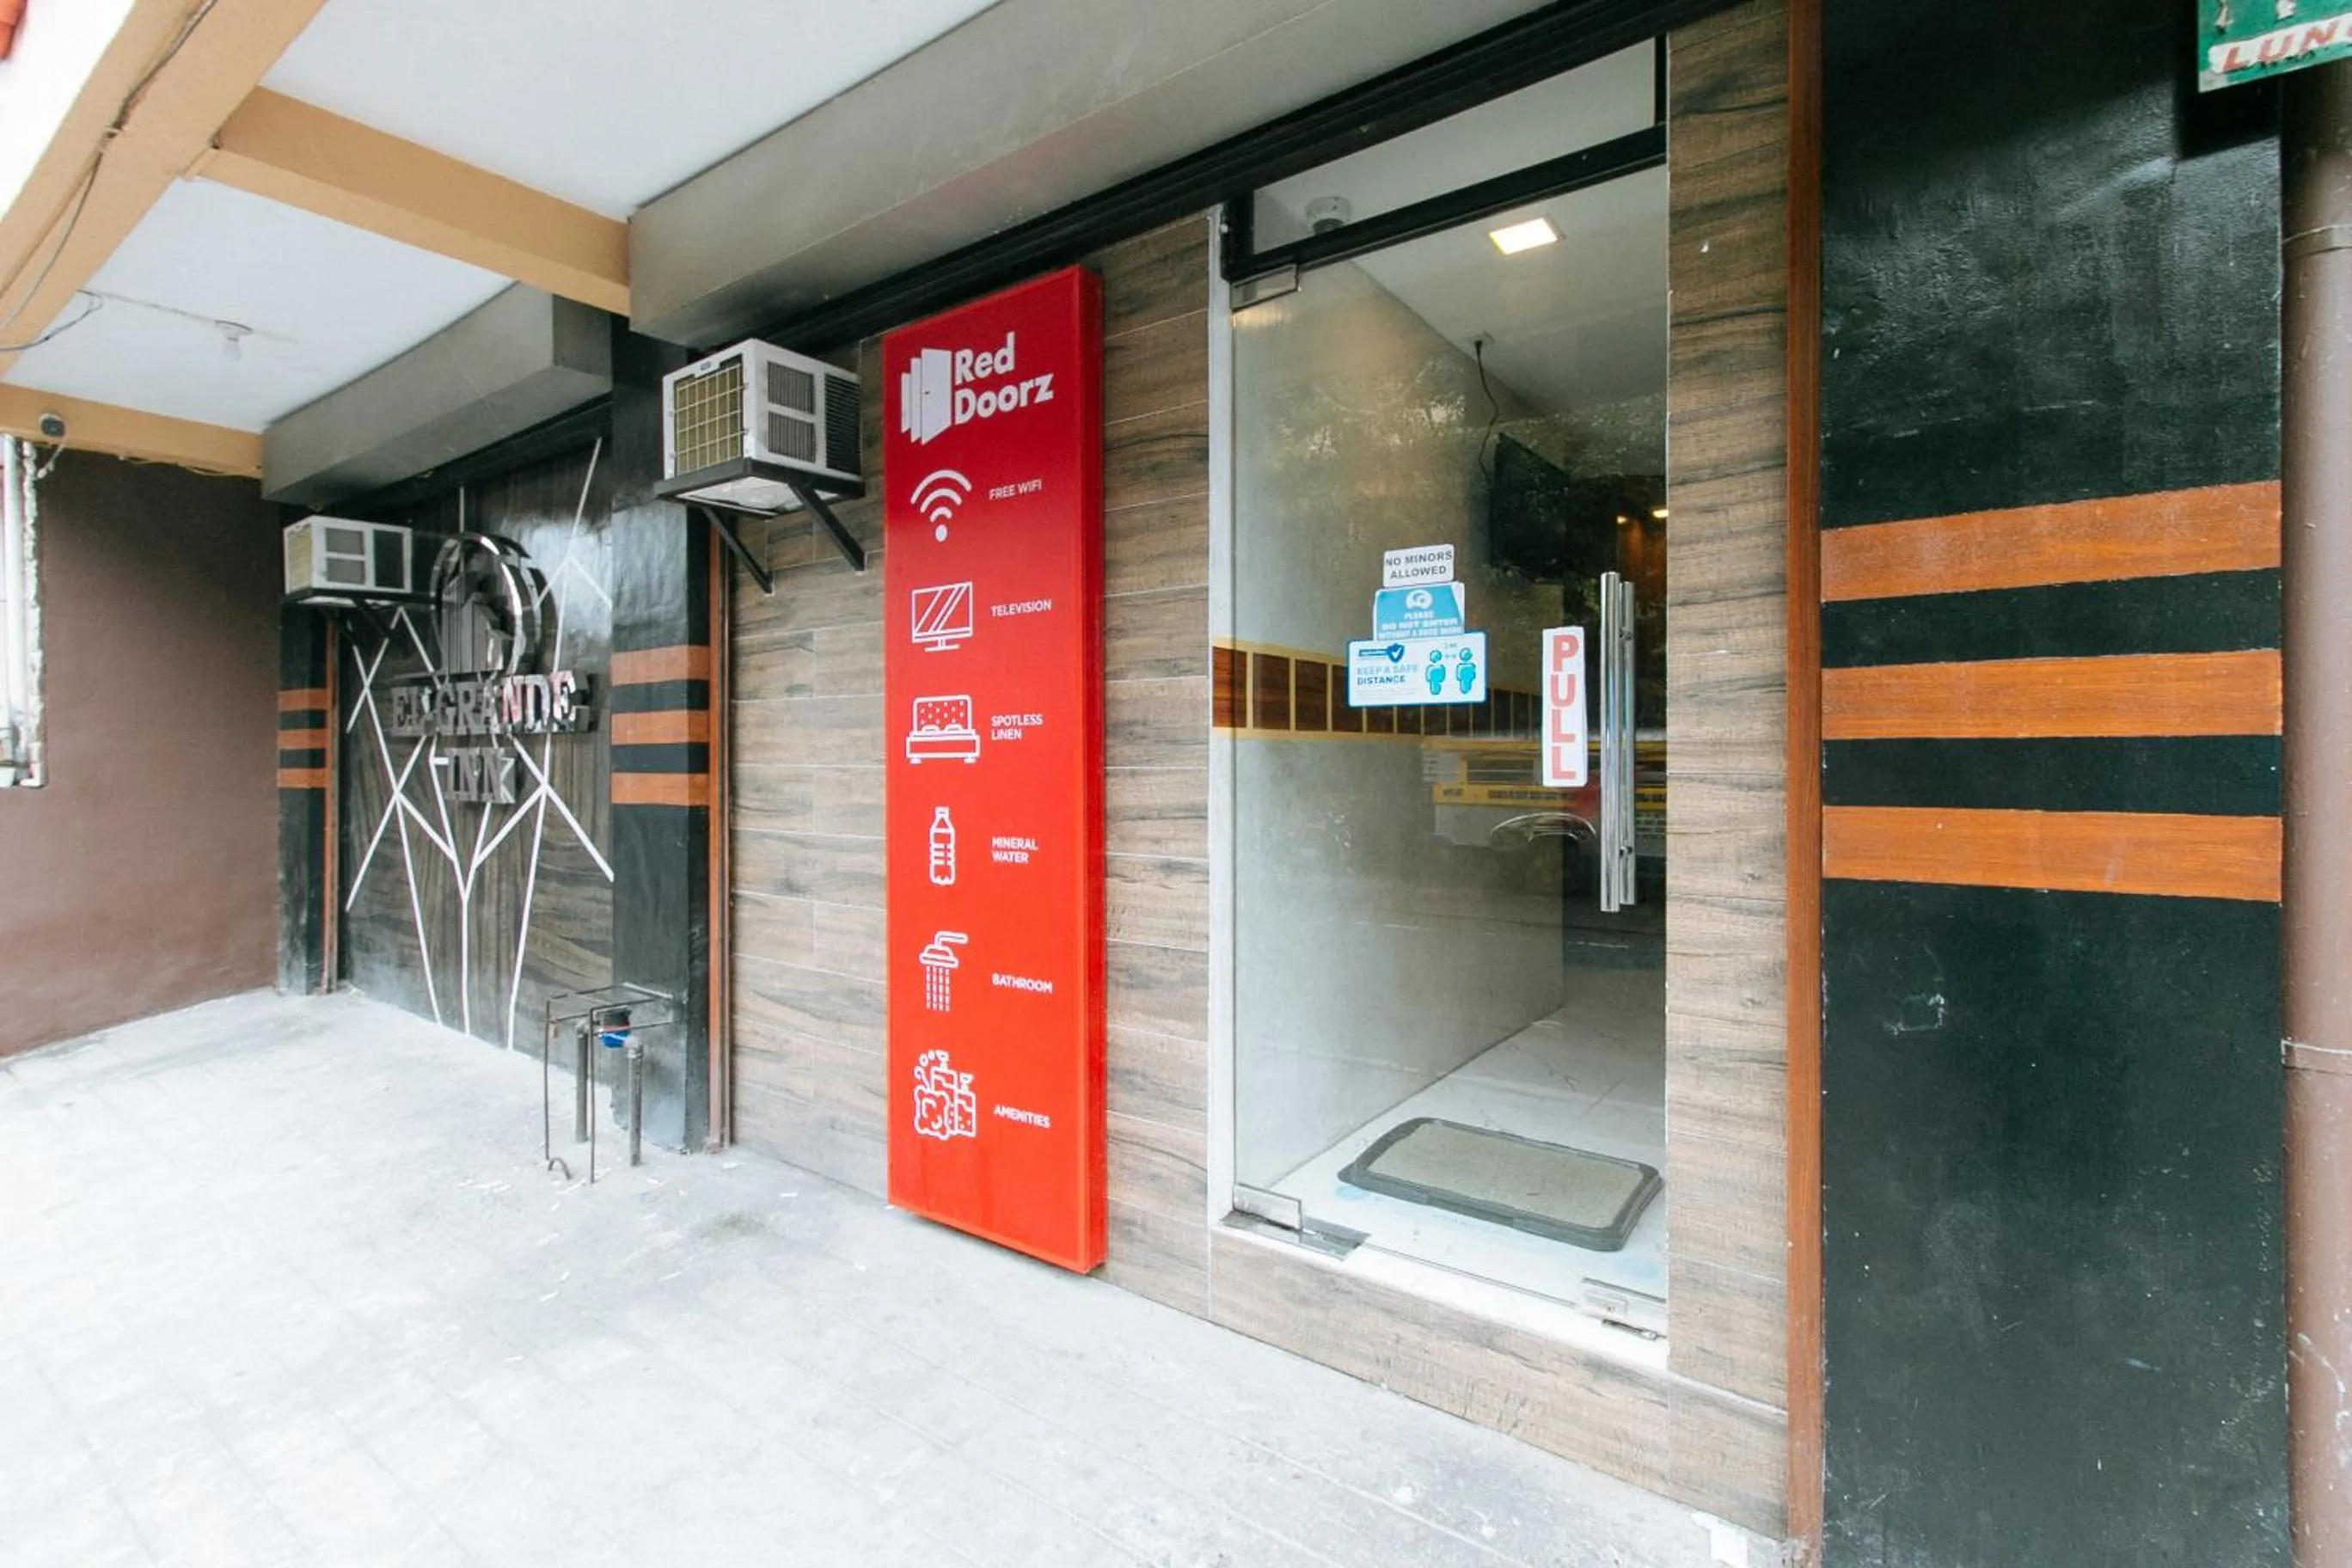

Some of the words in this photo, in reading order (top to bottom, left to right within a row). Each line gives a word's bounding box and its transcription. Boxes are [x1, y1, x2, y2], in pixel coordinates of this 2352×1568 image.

[2222, 20, 2352, 71] LUN
[954, 330, 1015, 386] Red
[954, 372, 1054, 426] Doorz
[989, 484, 1015, 500] FREE
[1018, 478, 1042, 495] WIFI
[1385, 557, 1400, 567] NO
[1405, 550, 1453, 564] MINORS
[1390, 566, 1446, 579] ALLOWED
[990, 599, 1052, 616] TELEVISION
[1381, 622, 1396, 631] DO
[1399, 620, 1419, 629] NOT
[1421, 617, 1458, 628] ENTER
[1357, 666, 1382, 676] KEEP
[1384, 665, 1391, 674] A
[1393, 664, 1418, 673] SAFE
[1357, 675, 1406, 685] DISTANCE
[1550, 634, 1579, 780] PULL
[990, 714, 1043, 727] SPOTLESS
[991, 729, 1022, 741] LINEN
[444, 746, 510, 803] INN
[991, 836, 1038, 851] MINERAL
[992, 850, 1029, 863] WATER
[991, 972, 1053, 994] BATHROOM
[994, 1105, 1050, 1129] AMENITIES
